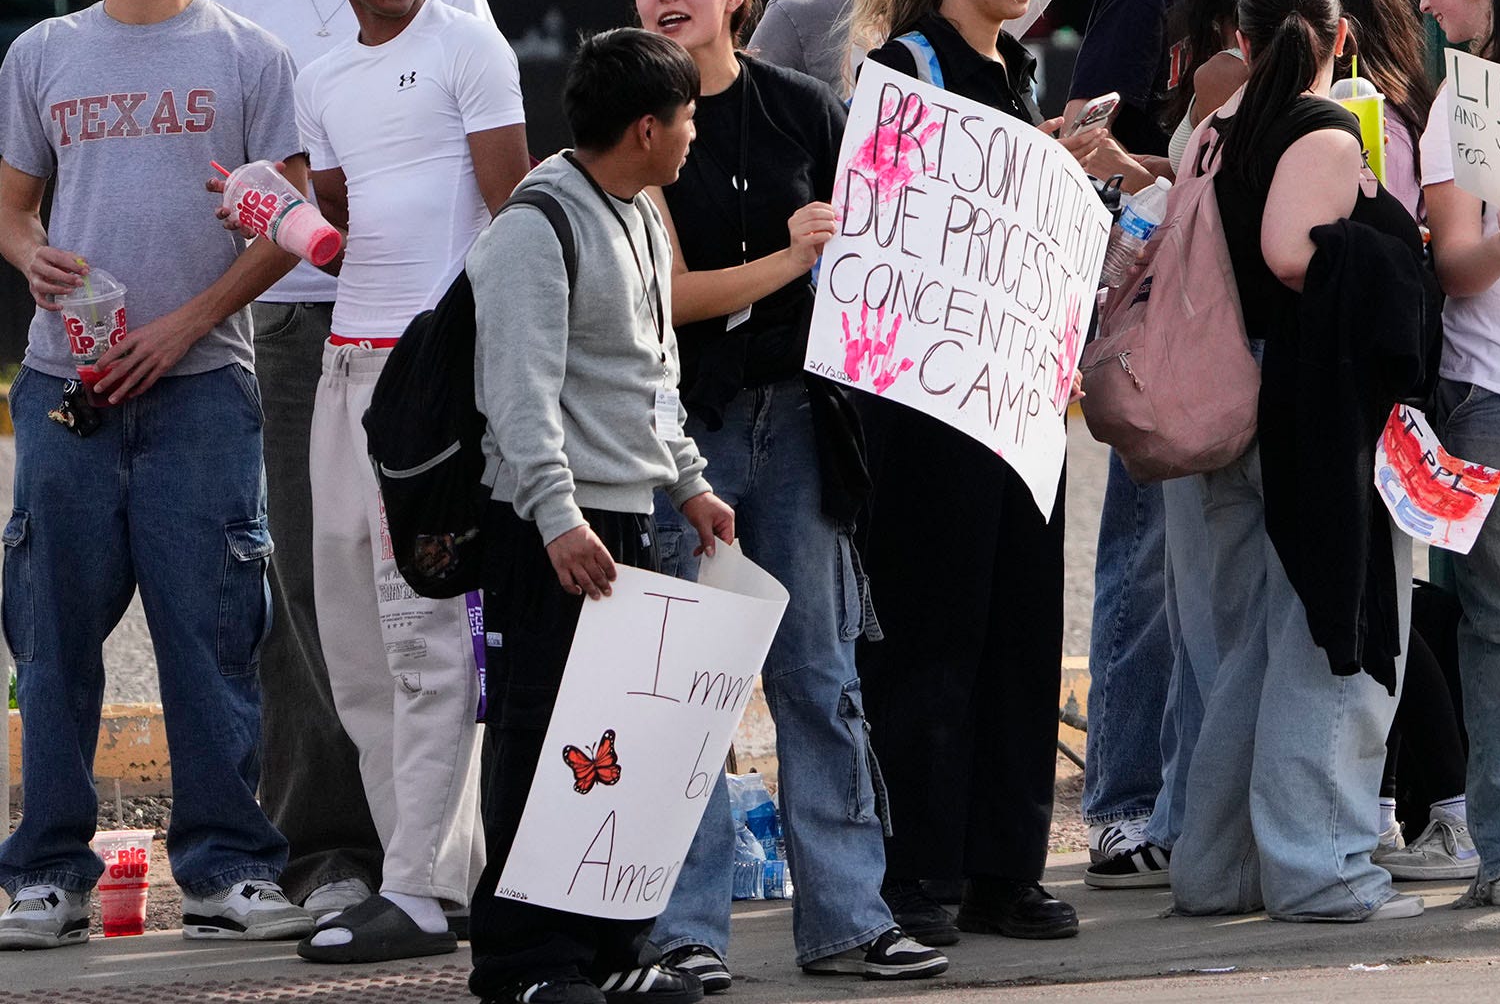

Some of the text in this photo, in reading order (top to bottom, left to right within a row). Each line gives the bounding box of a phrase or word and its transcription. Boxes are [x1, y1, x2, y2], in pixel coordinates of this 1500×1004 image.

[50, 88, 218, 147] TEXAS
[1454, 104, 1487, 132] AND
[1457, 142, 1493, 172] FOR
[873, 82, 1110, 294] PRISON WITHOUT
[841, 168, 928, 260] DUE
[940, 194, 1056, 322] PROCESS
[919, 338, 1041, 444] CAMP
[109, 862, 149, 880] GULP
